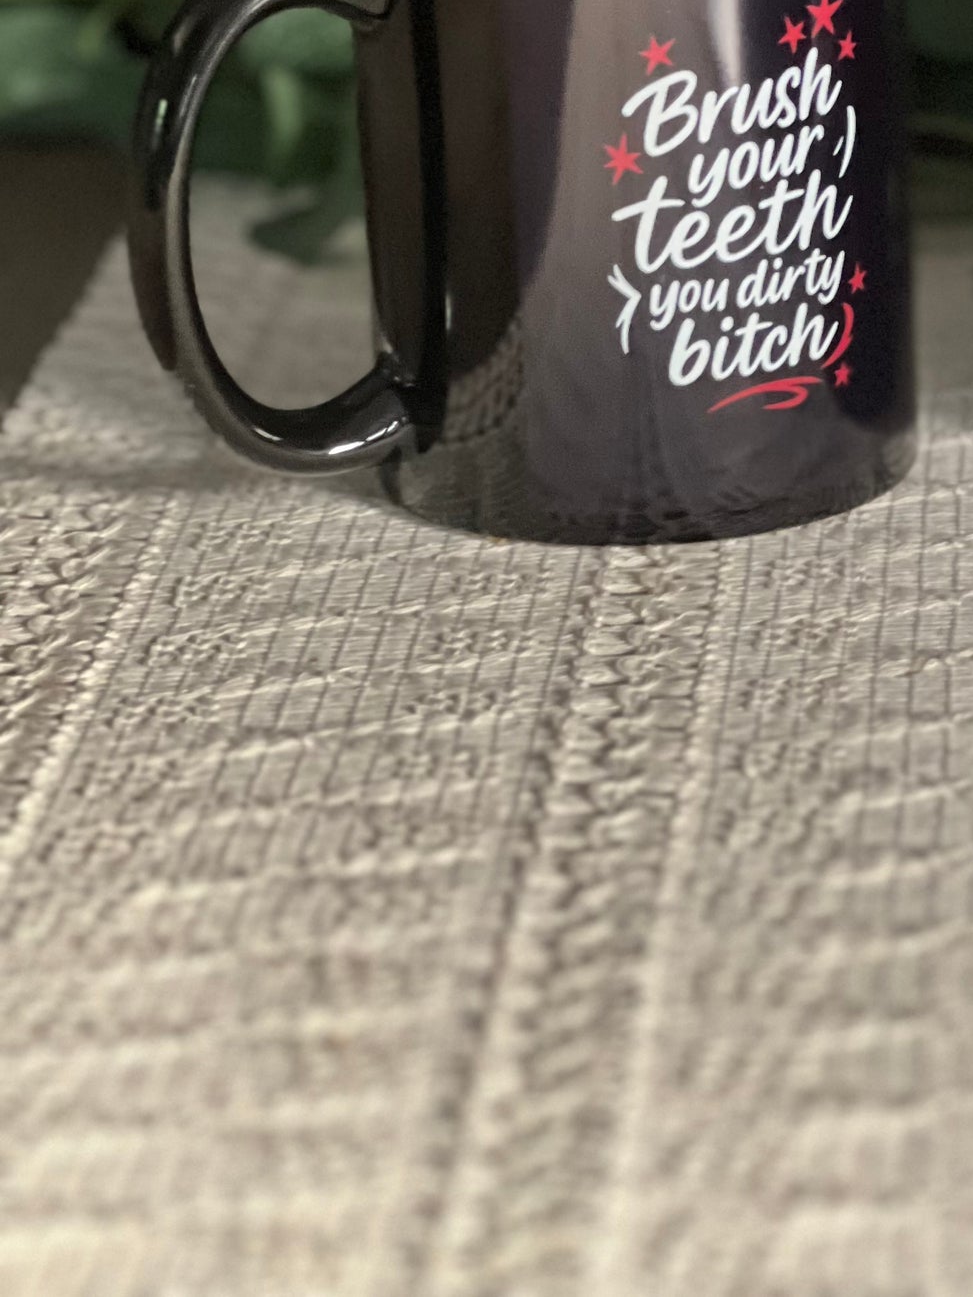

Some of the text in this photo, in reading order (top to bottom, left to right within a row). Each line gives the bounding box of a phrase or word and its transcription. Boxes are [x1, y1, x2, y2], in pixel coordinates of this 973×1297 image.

[621, 47, 842, 157] Brush
[688, 124, 824, 207] your
[611, 169, 853, 273] teeth
[649, 248, 845, 330] you dirty
[668, 302, 839, 386] bitch
